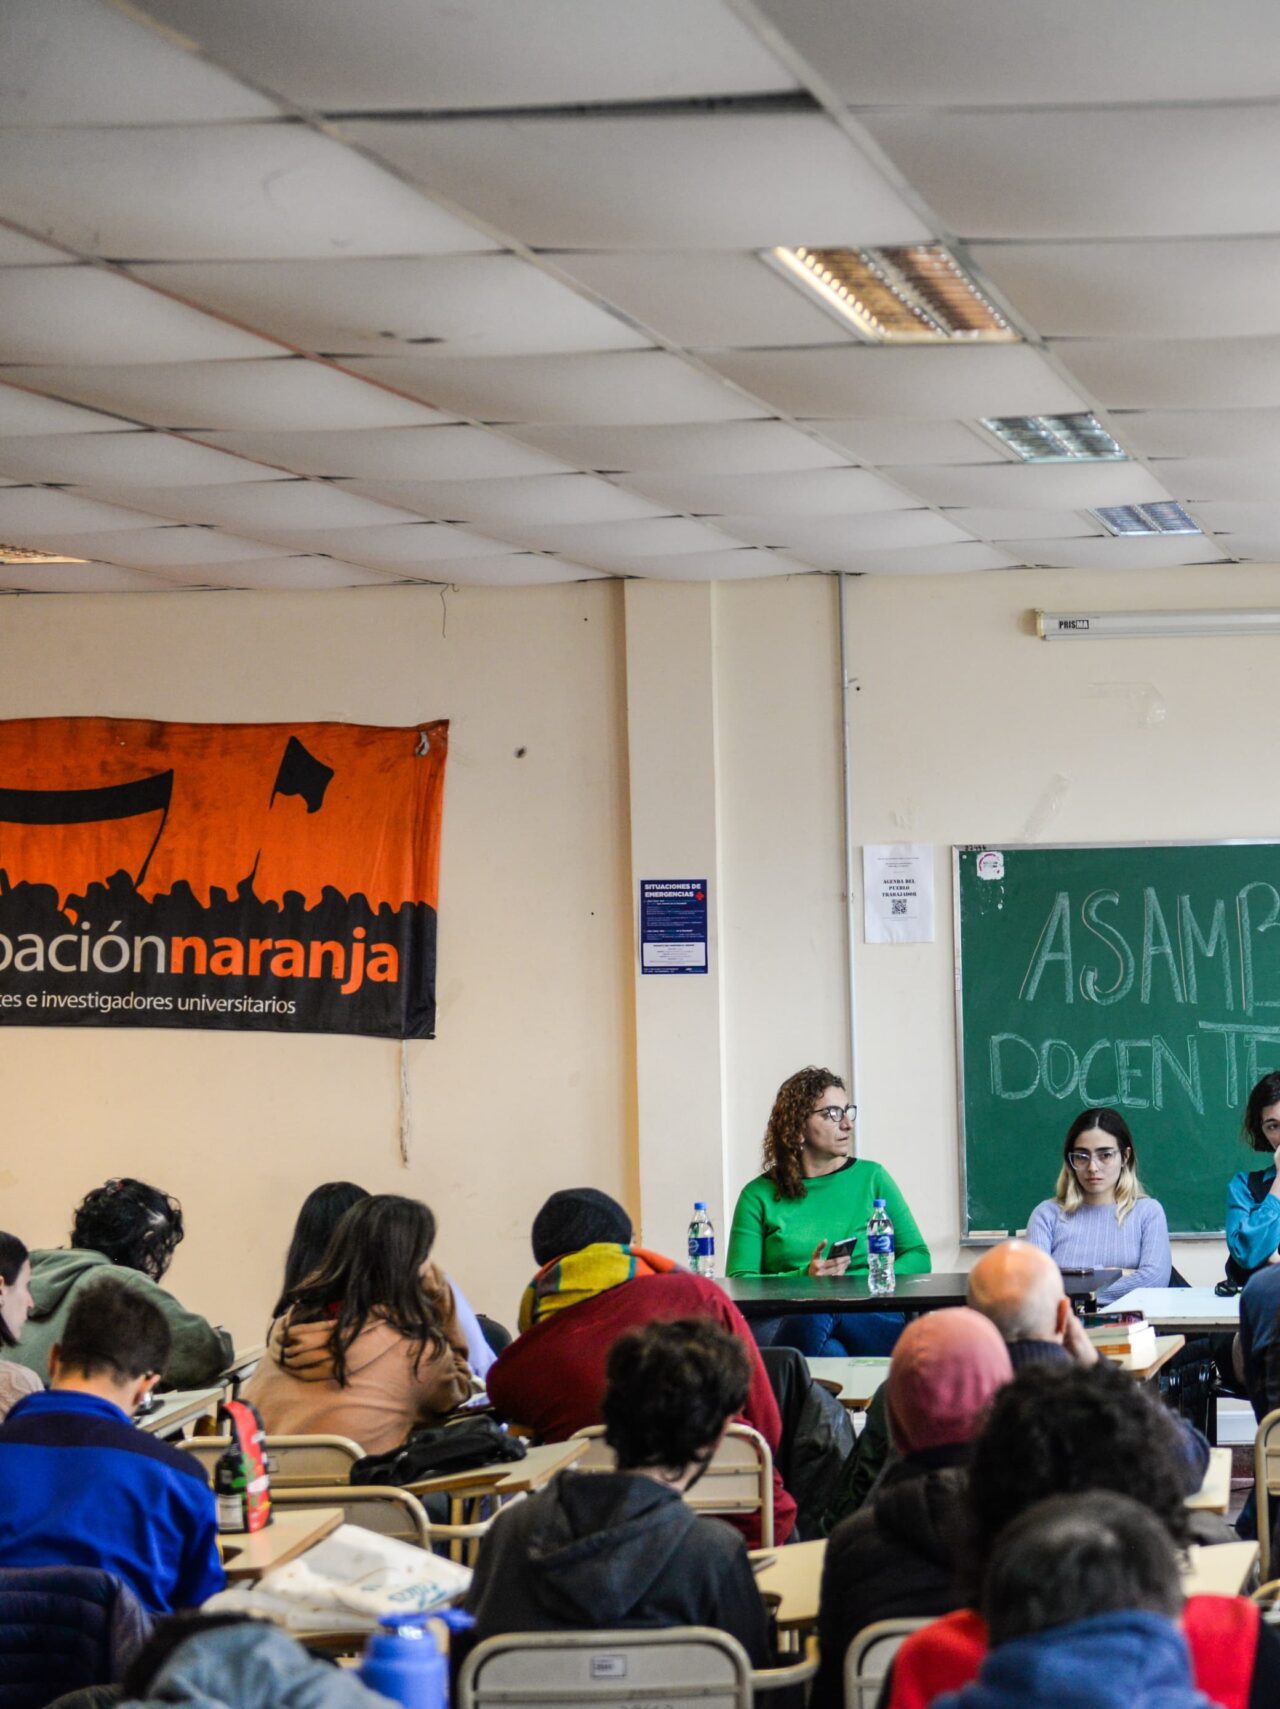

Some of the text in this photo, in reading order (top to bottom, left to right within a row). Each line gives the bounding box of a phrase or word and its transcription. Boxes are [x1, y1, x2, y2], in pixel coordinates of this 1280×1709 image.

[26, 994, 38, 1008] e
[41, 990, 173, 1013] investigadores
[177, 993, 296, 1015] universitarios
